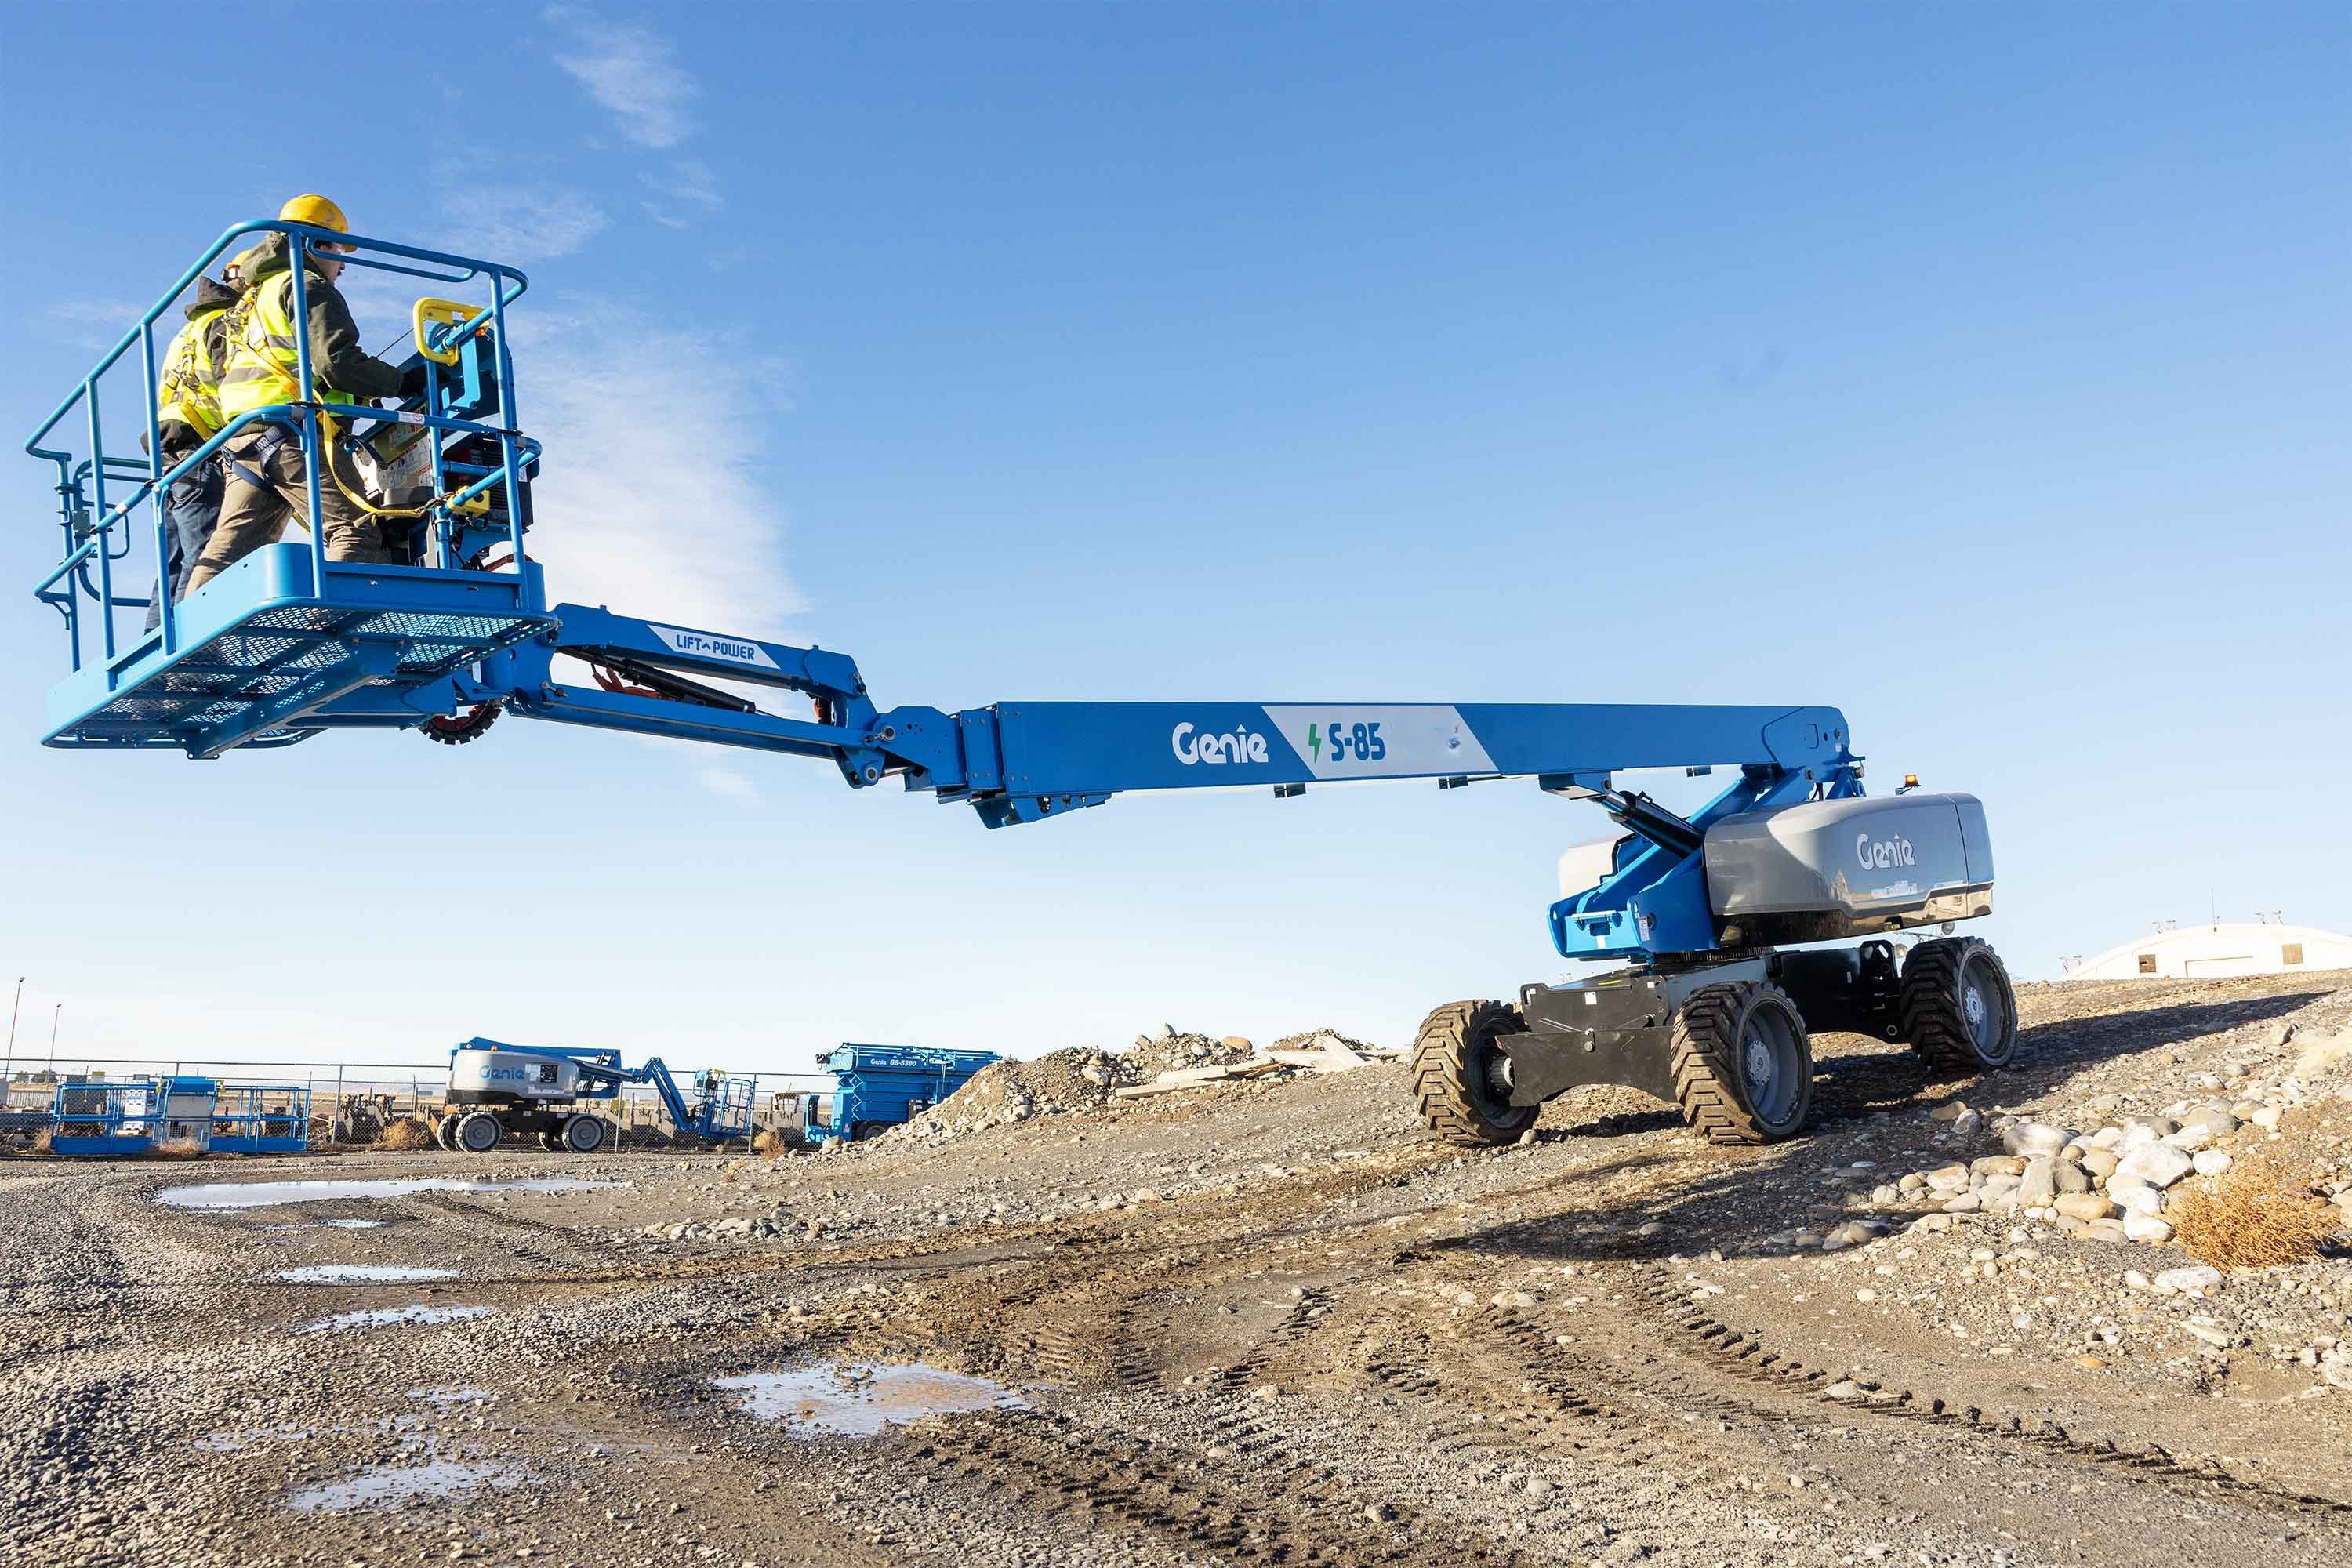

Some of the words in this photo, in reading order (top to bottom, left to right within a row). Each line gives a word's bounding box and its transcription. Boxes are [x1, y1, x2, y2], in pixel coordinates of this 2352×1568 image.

[677, 634, 702, 651] LIFT
[713, 641, 754, 660] POWER
[1172, 722, 1269, 765] Genie
[1329, 722, 1385, 761] S-85
[1857, 833, 1915, 870] Genie
[480, 1065, 524, 1080] Genie
